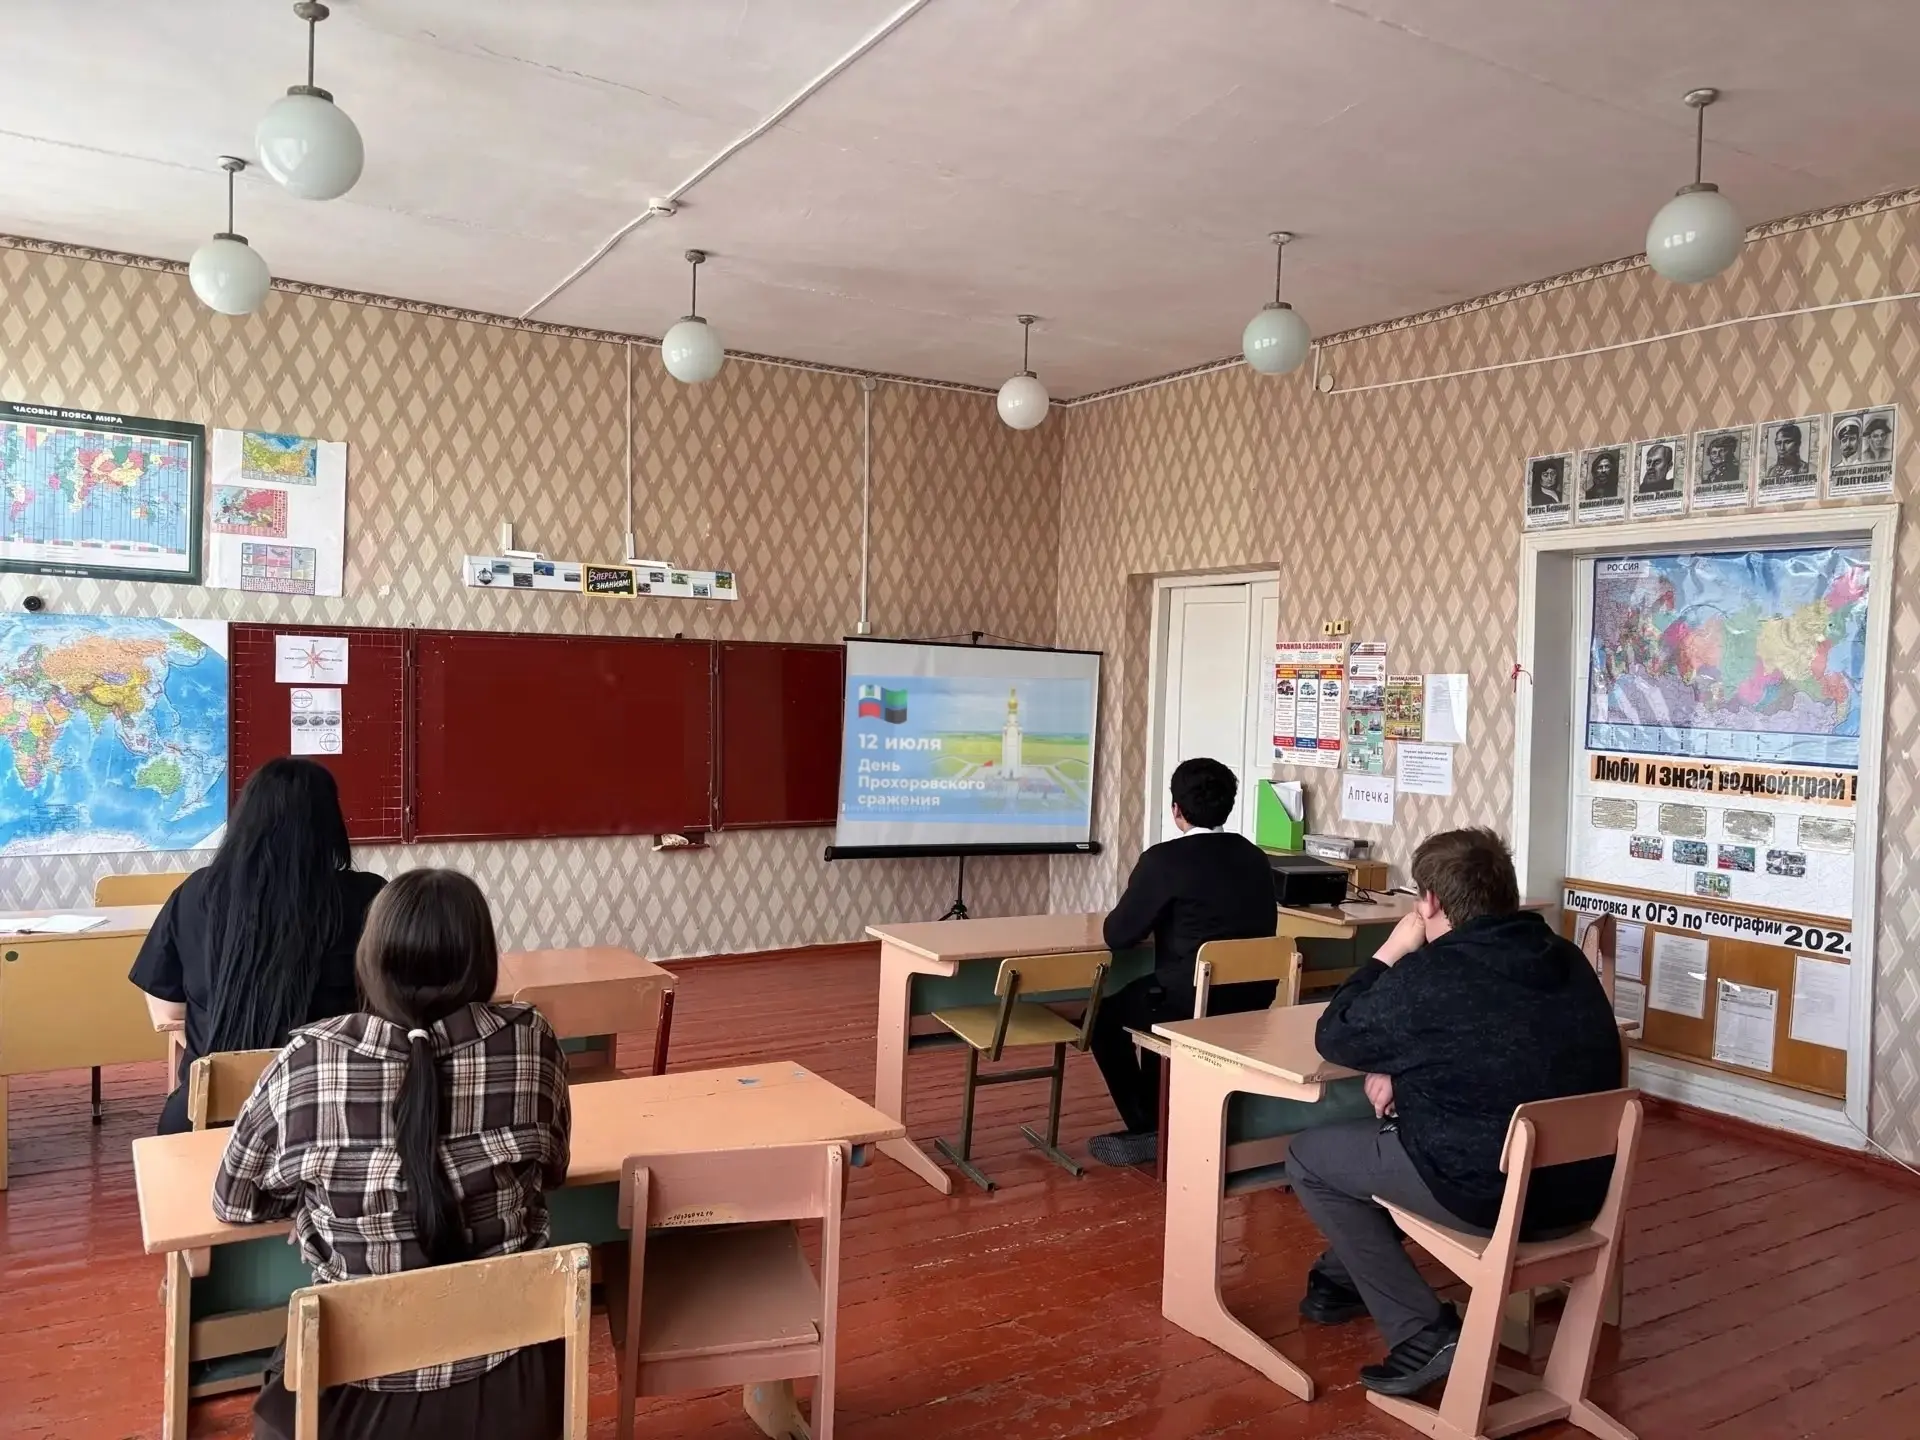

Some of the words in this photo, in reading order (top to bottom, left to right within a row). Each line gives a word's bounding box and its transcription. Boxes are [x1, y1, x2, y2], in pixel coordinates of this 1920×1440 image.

[13, 404, 58, 417] ЧАСОВЫЕ
[61, 410, 92, 420] ПОЯСА
[95, 414, 123, 424] МИРА
[1836, 473, 1885, 487] Лаптевы
[1527, 506, 1545, 516] Витус
[1607, 562, 1640, 571] РОССИЯ
[596, 579, 631, 590] ЗНАНИЯМ!
[1302, 642, 1343, 650] БЕЗОПАСНОСТИ
[858, 734, 879, 750] 12
[884, 736, 942, 751] июля
[857, 758, 901, 774] День
[1595, 755, 1640, 784] Люби
[1659, 764, 1714, 791] знай
[858, 775, 986, 792] Прохоровского
[857, 793, 941, 807] сражения
[1348, 786, 1389, 804] Аптечка
[1566, 890, 1628, 916] Подготовка
[1631, 904, 1641, 919] к
[1645, 902, 1678, 926] ОГЭ
[1682, 913, 1702, 930] по
[1704, 911, 1783, 936] географии
